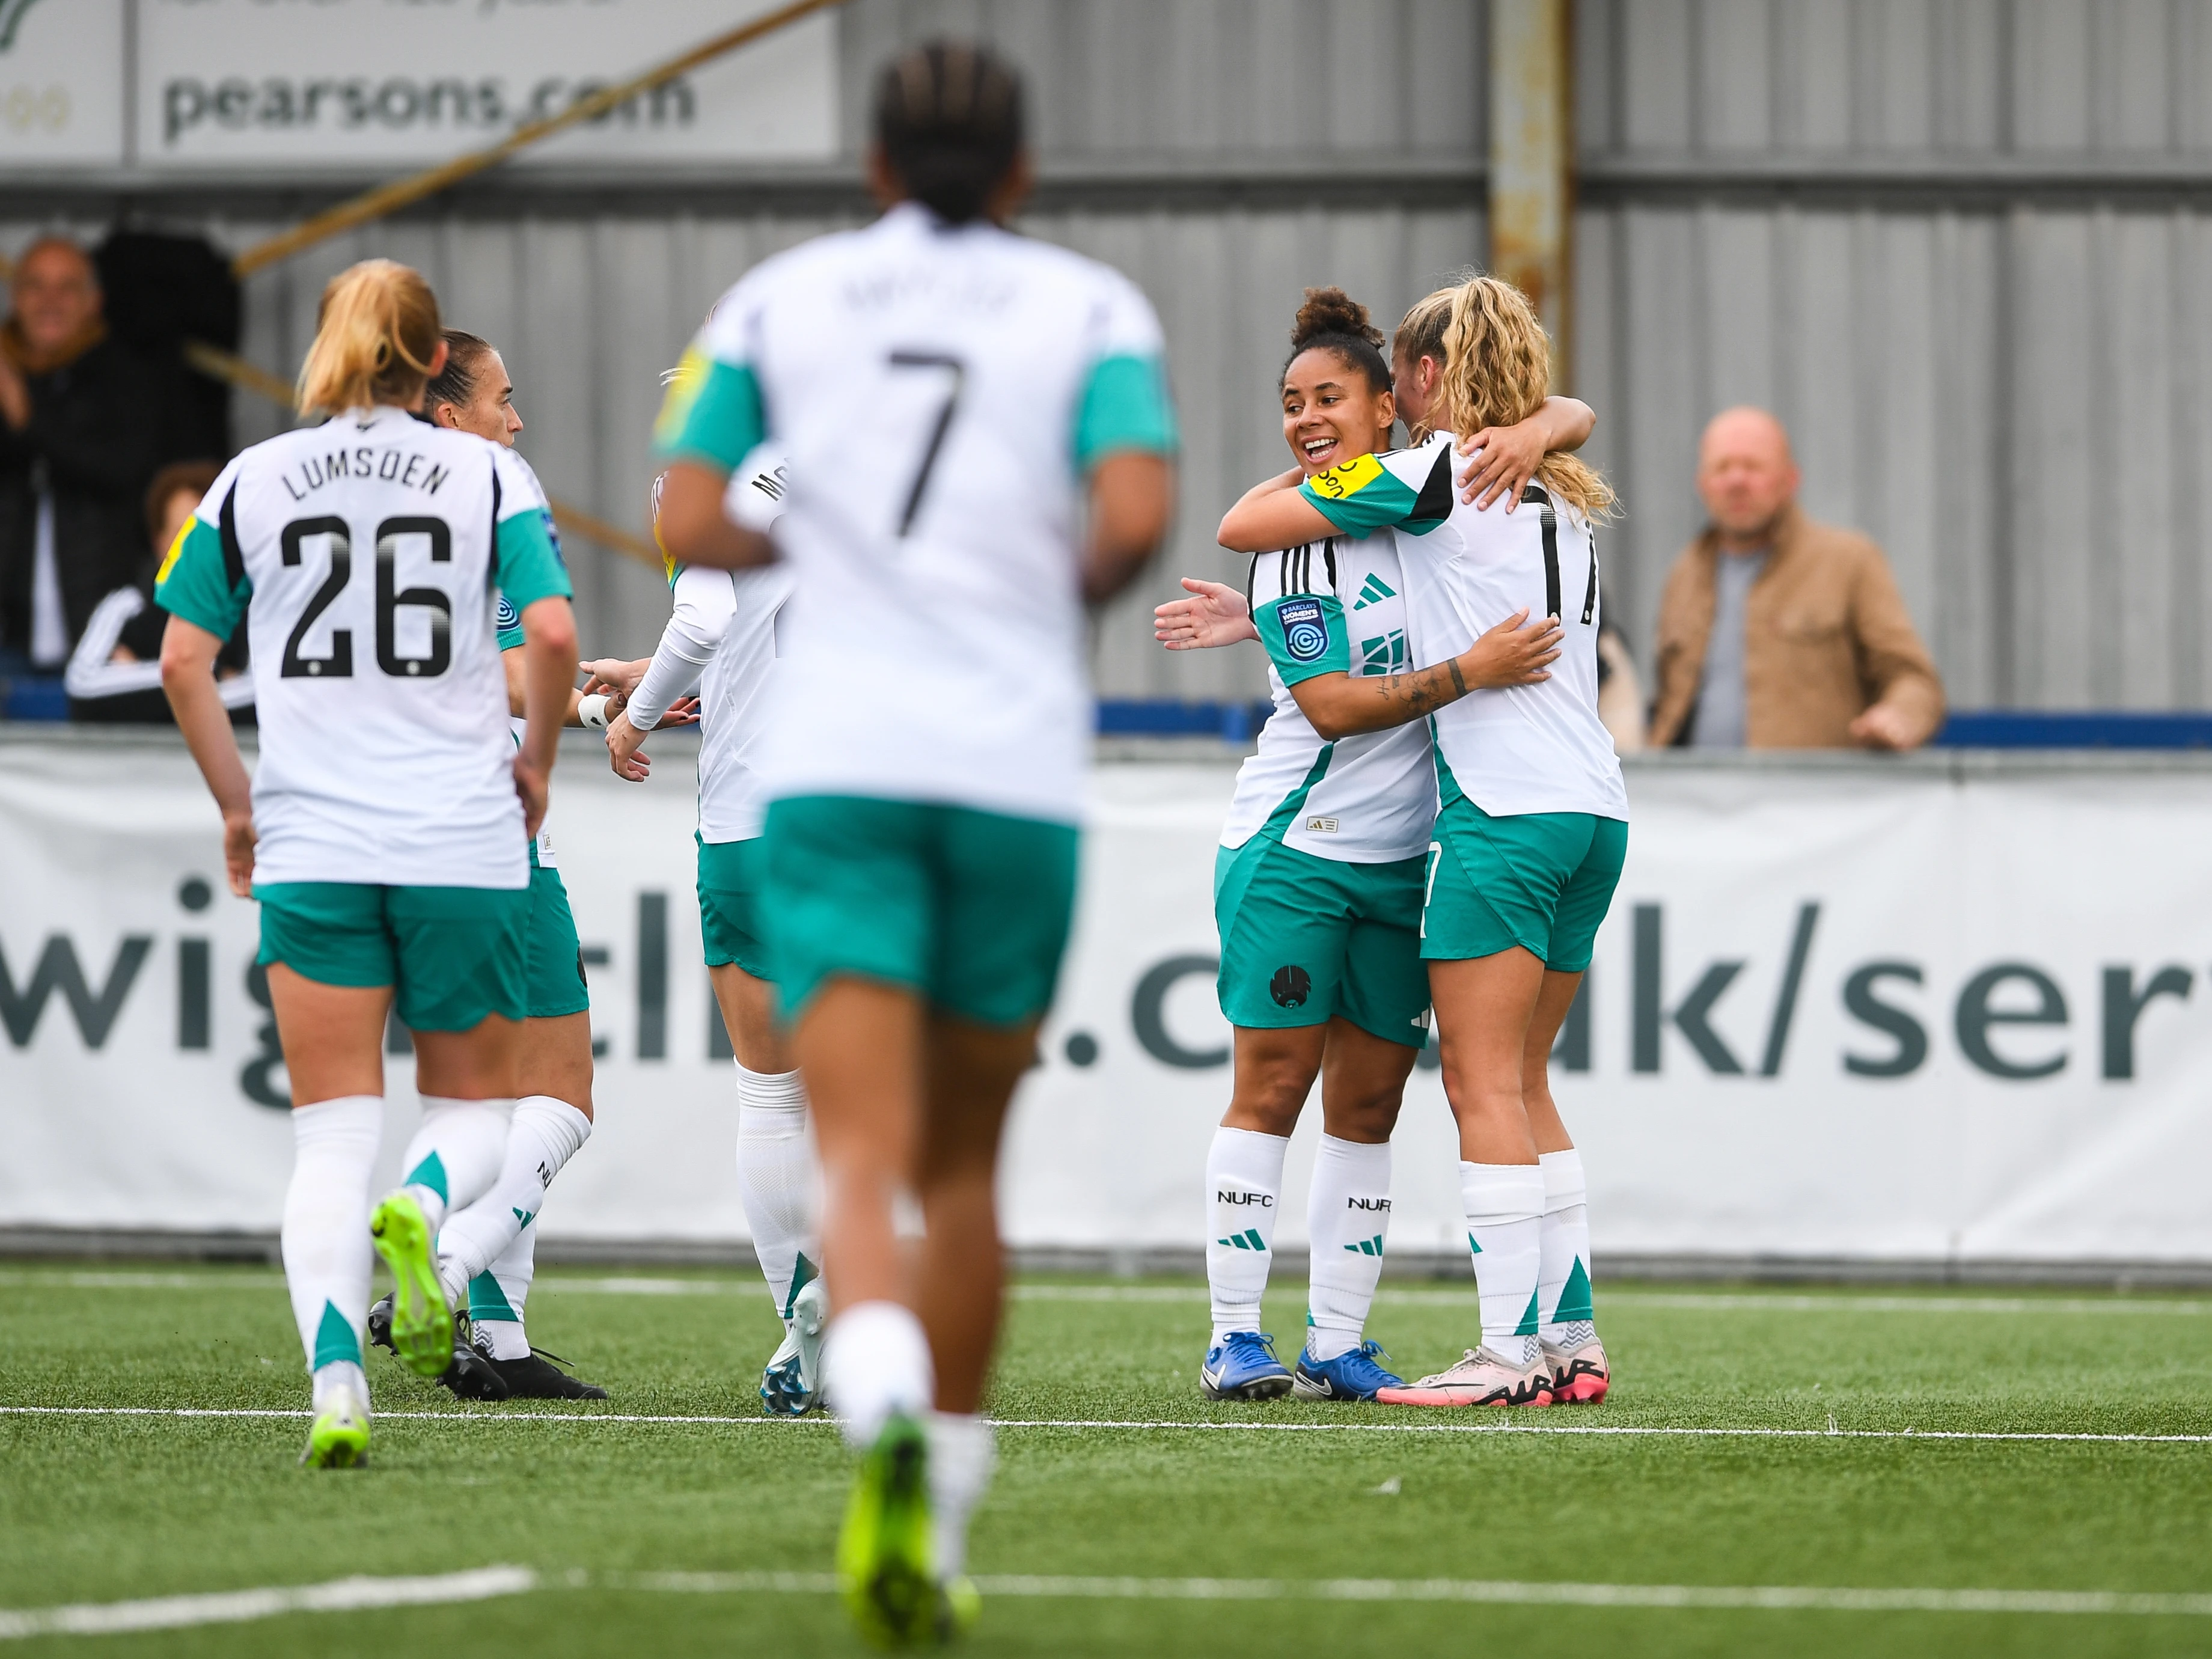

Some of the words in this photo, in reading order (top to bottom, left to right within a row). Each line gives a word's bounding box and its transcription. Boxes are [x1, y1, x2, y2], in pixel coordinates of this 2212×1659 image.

[163, 77, 696, 144] pearsons.com
[888, 347, 967, 539] 7
[281, 447, 450, 500] LUMSDEN
[280, 516, 451, 678] 26
[1288, 603, 1317, 612] BARCLAYS
[1218, 1190, 1274, 1208] NUFC
